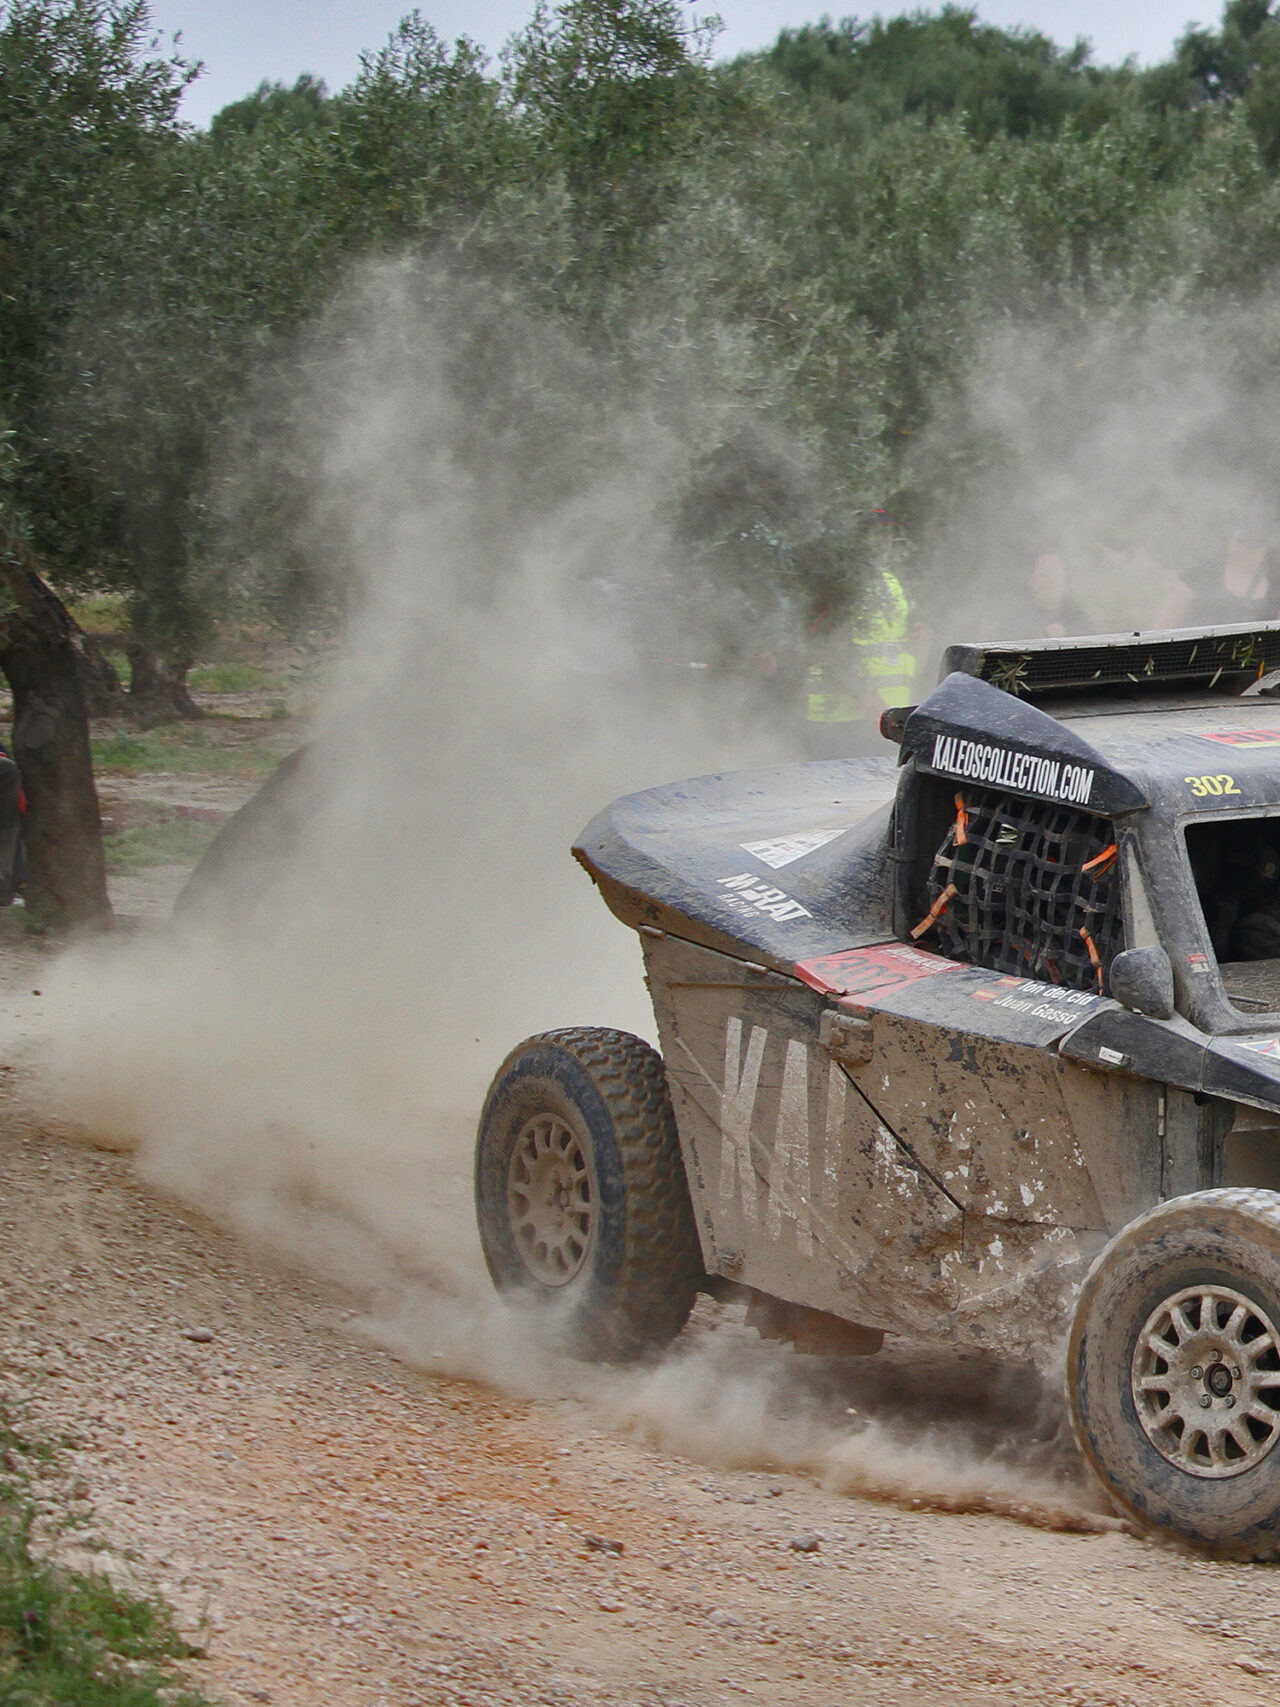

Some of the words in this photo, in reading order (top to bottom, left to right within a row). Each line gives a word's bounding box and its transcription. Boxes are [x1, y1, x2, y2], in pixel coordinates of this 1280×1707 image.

[931, 734, 1095, 805] KALEOSCOLLECTION.COM
[1184, 774, 1242, 797] 302
[716, 893, 760, 918] RACING
[993, 994, 1033, 1013] Juan
[1030, 1003, 1080, 1025] Gassó
